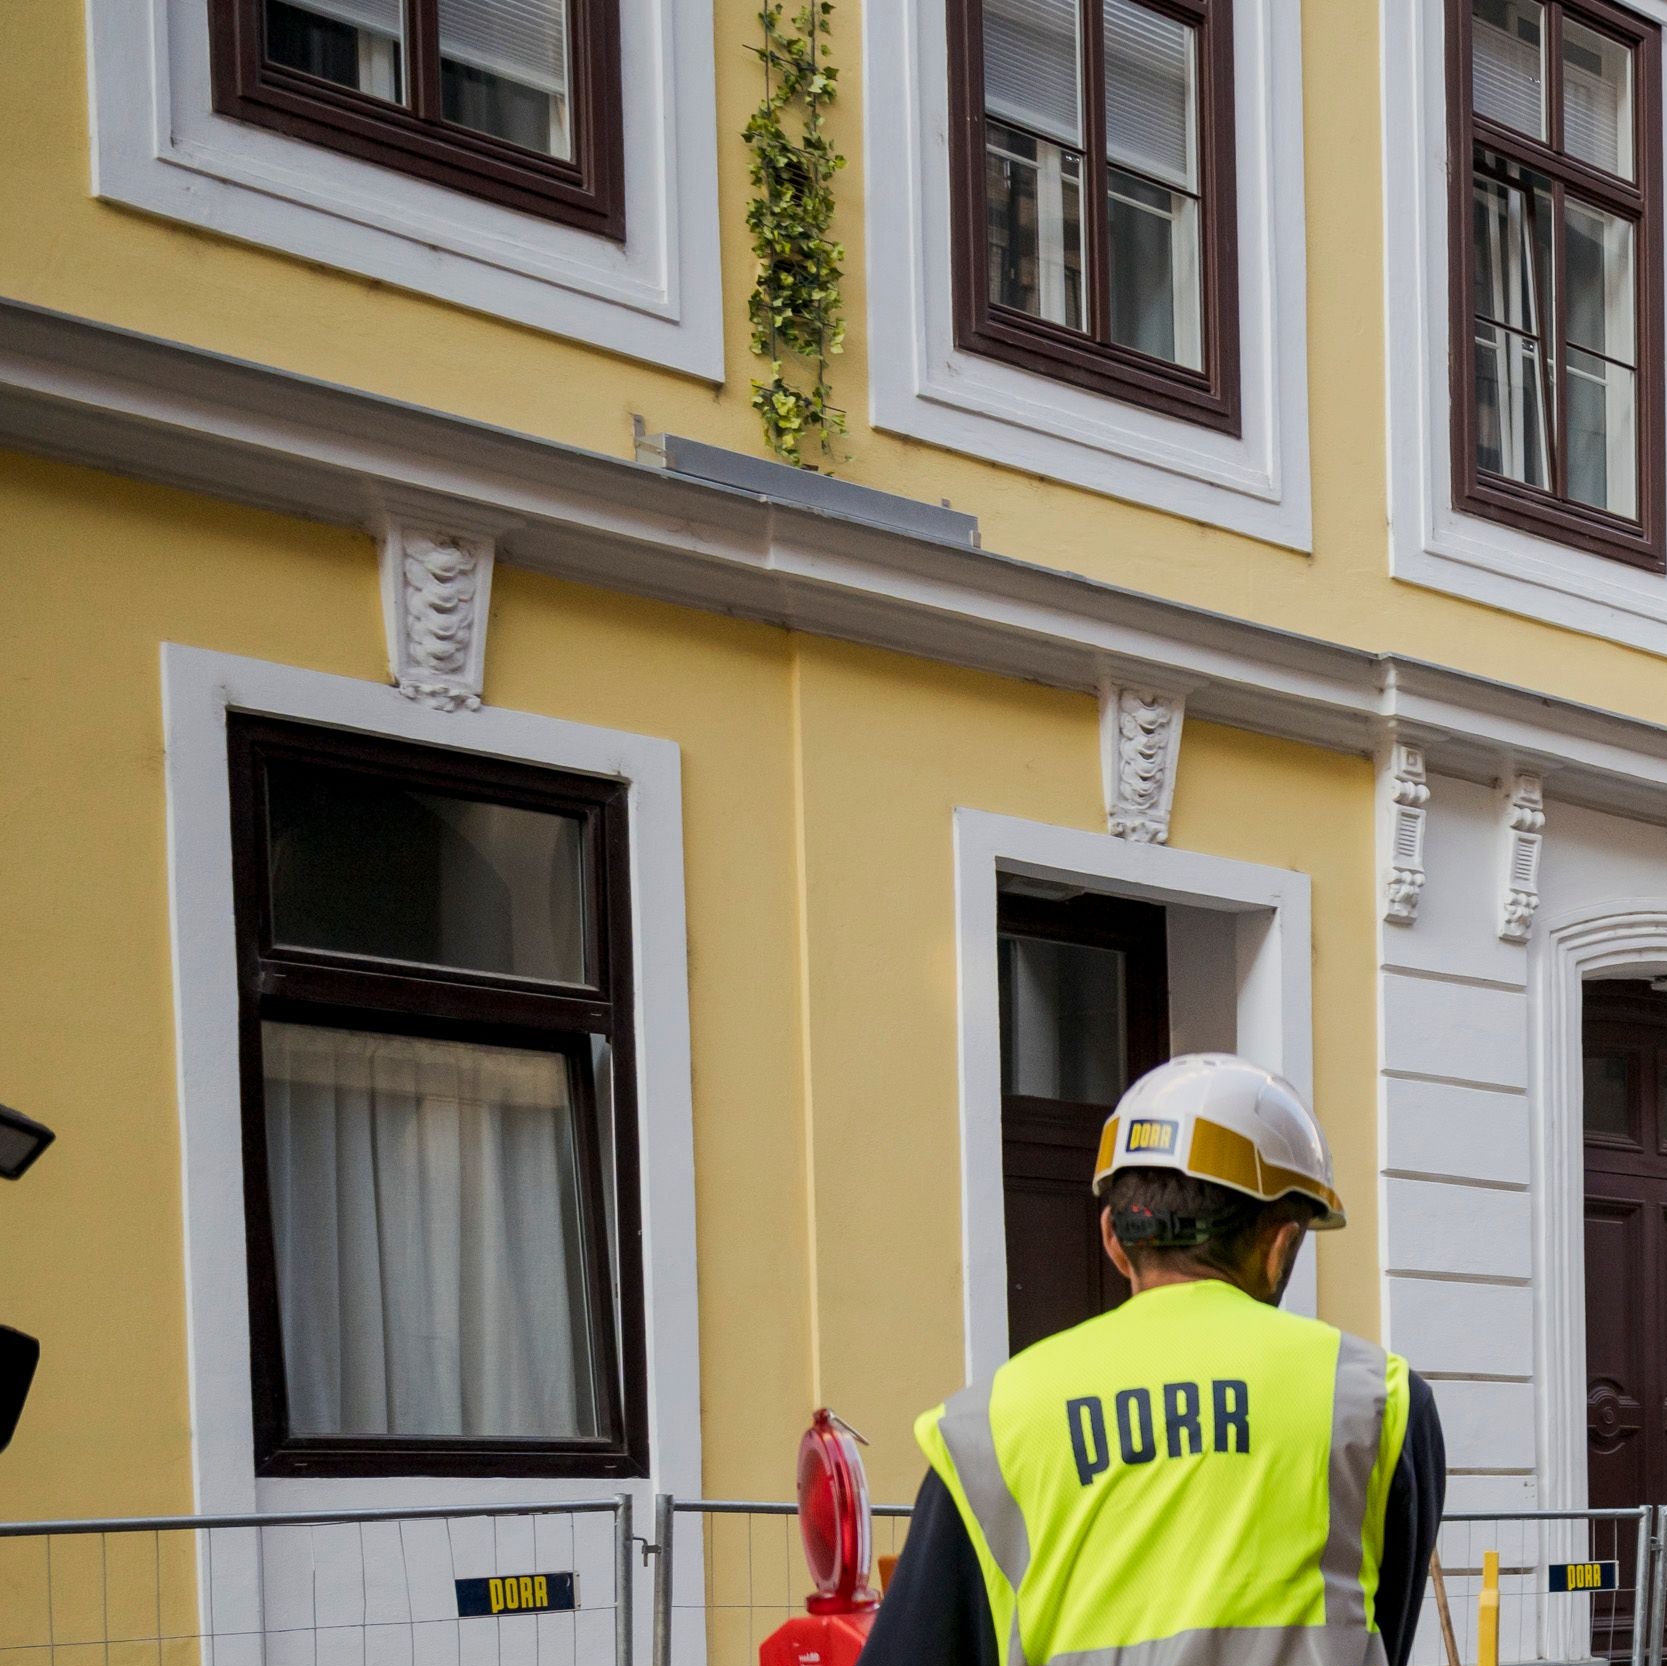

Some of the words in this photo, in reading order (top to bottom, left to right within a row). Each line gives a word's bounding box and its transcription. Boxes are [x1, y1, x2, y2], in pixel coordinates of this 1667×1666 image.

[1065, 1378, 1251, 1487] PORR
[489, 1575, 549, 1614] PORR
[1567, 1563, 1602, 1591] PORR
